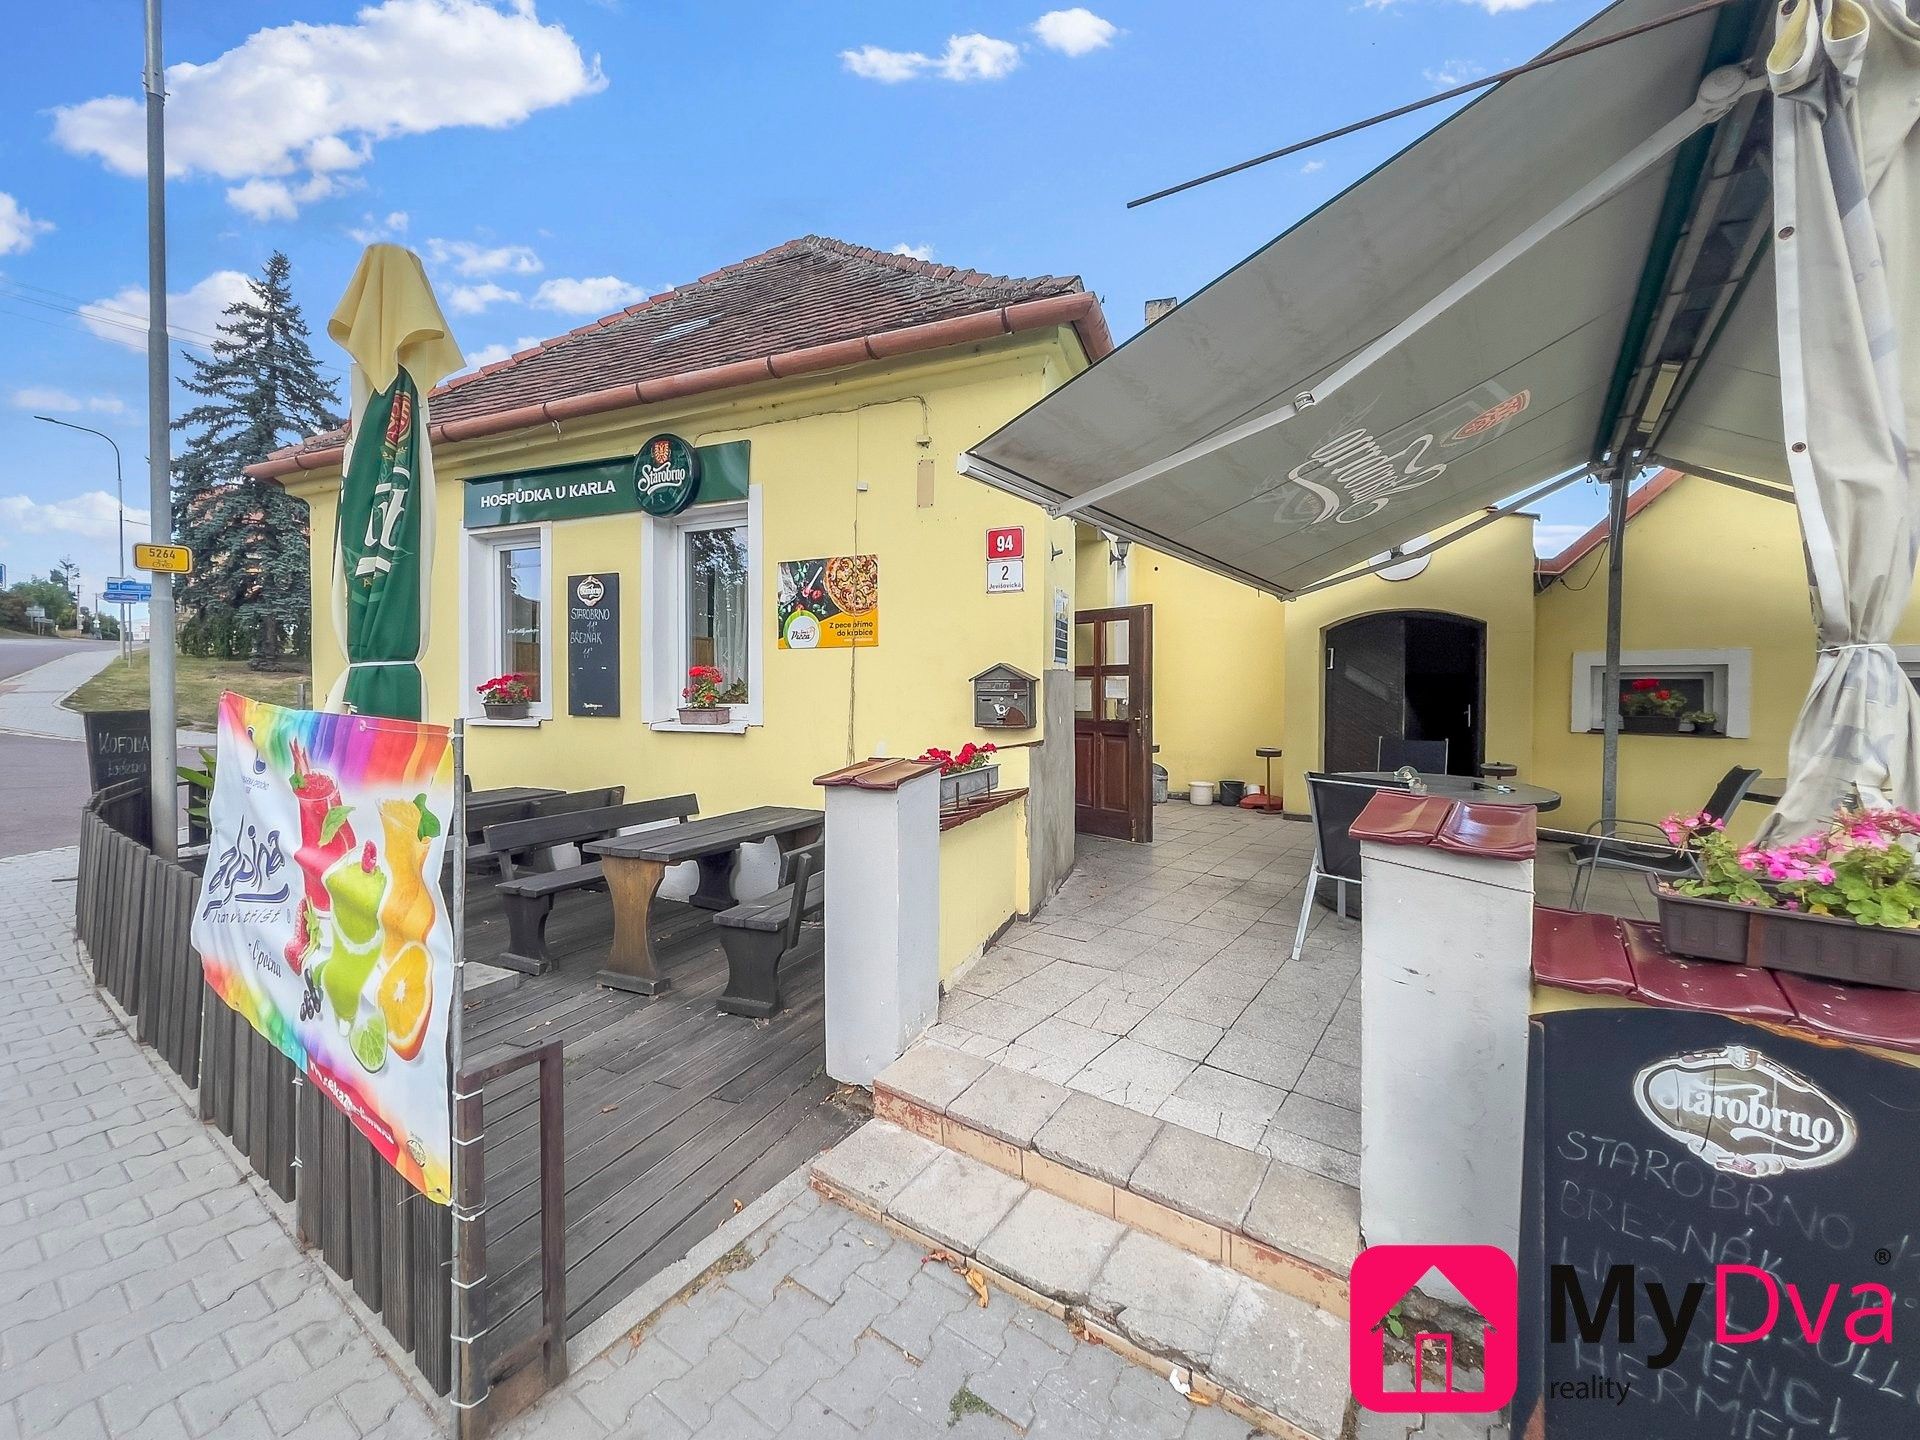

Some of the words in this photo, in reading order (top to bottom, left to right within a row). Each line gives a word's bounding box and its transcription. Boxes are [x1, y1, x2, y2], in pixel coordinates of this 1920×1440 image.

[638, 461, 686, 495] Starobrno
[480, 488, 553, 508] HOSPŮDKA
[555, 486, 566, 499] U
[569, 480, 616, 497] KARLA
[996, 534, 1014, 552] 94
[149, 548, 176, 560] 5264
[1001, 565, 1009, 581] 2
[836, 629, 846, 637] do
[1557, 1130, 1855, 1250] STAROBRNO
